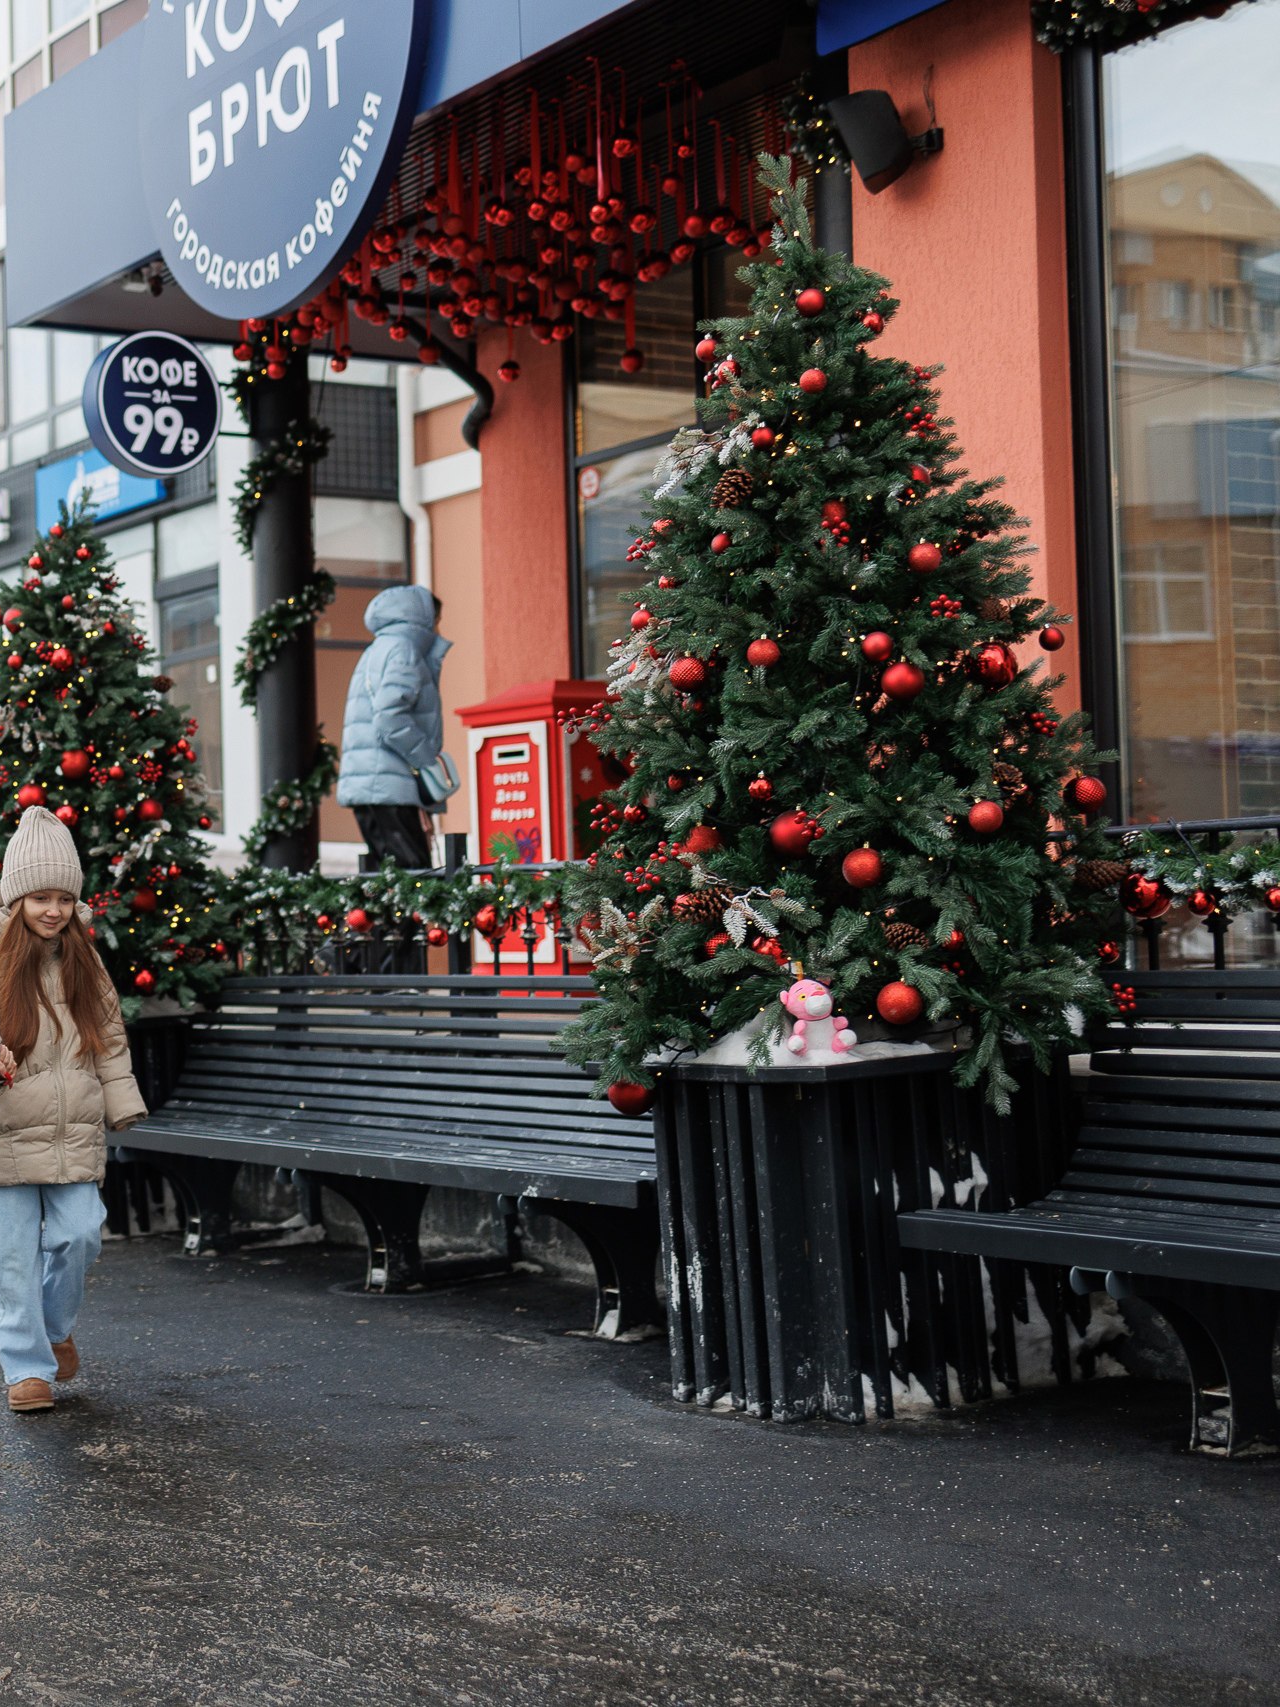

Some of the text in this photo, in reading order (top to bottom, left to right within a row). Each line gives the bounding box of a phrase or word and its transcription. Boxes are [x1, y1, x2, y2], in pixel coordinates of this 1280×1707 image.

[188, 18, 345, 187] БРЮТ
[166, 91, 382, 290] городская кофейня
[122, 356, 197, 388] КОФЕ
[152, 388, 171, 405] ЗА
